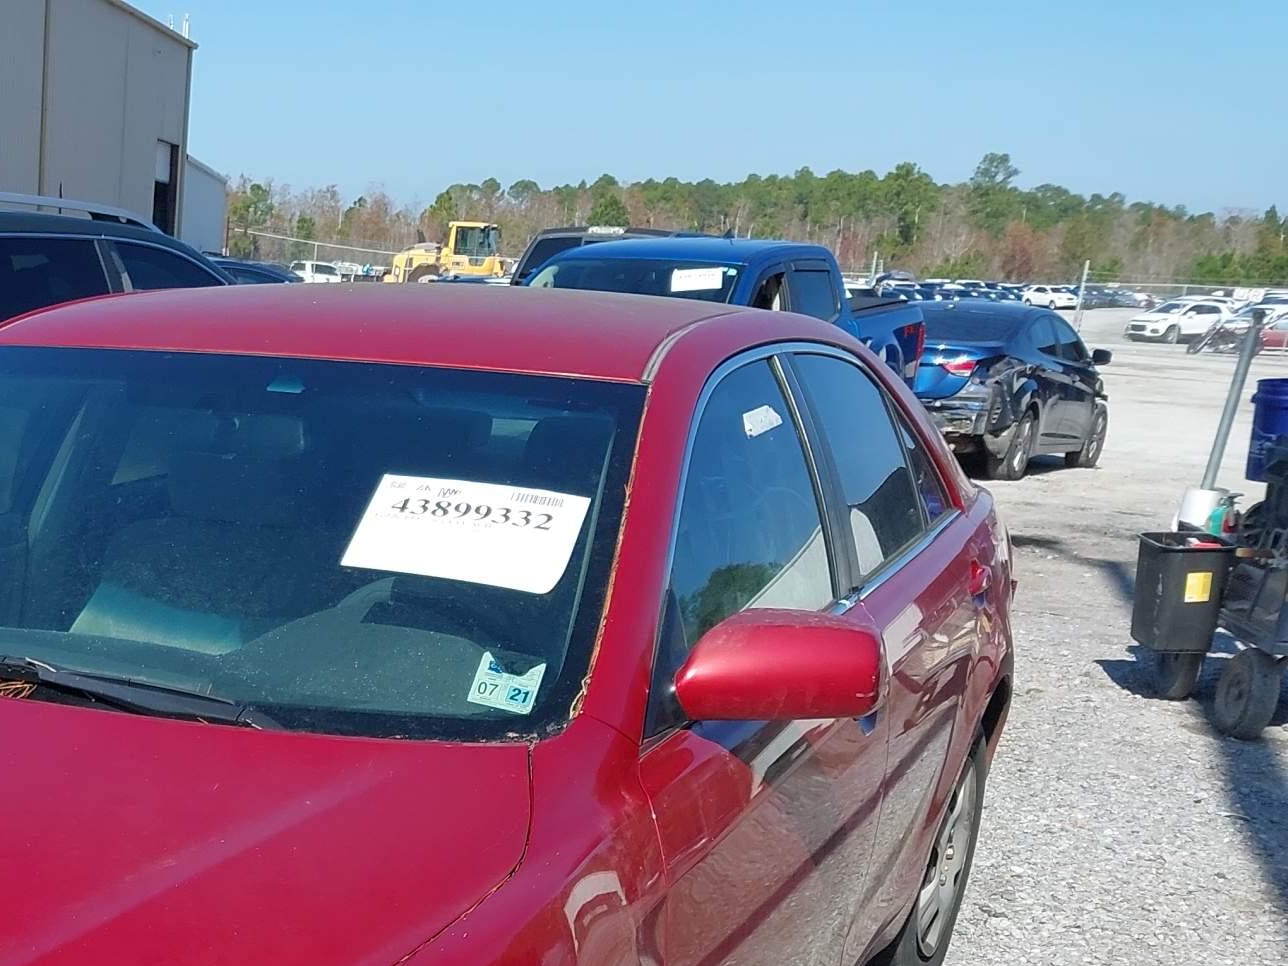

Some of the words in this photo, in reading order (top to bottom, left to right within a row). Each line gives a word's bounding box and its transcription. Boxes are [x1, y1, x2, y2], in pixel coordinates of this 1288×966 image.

[391, 497, 554, 531] 43899332
[478, 681, 499, 696] 07
[509, 687, 530, 704] 21
